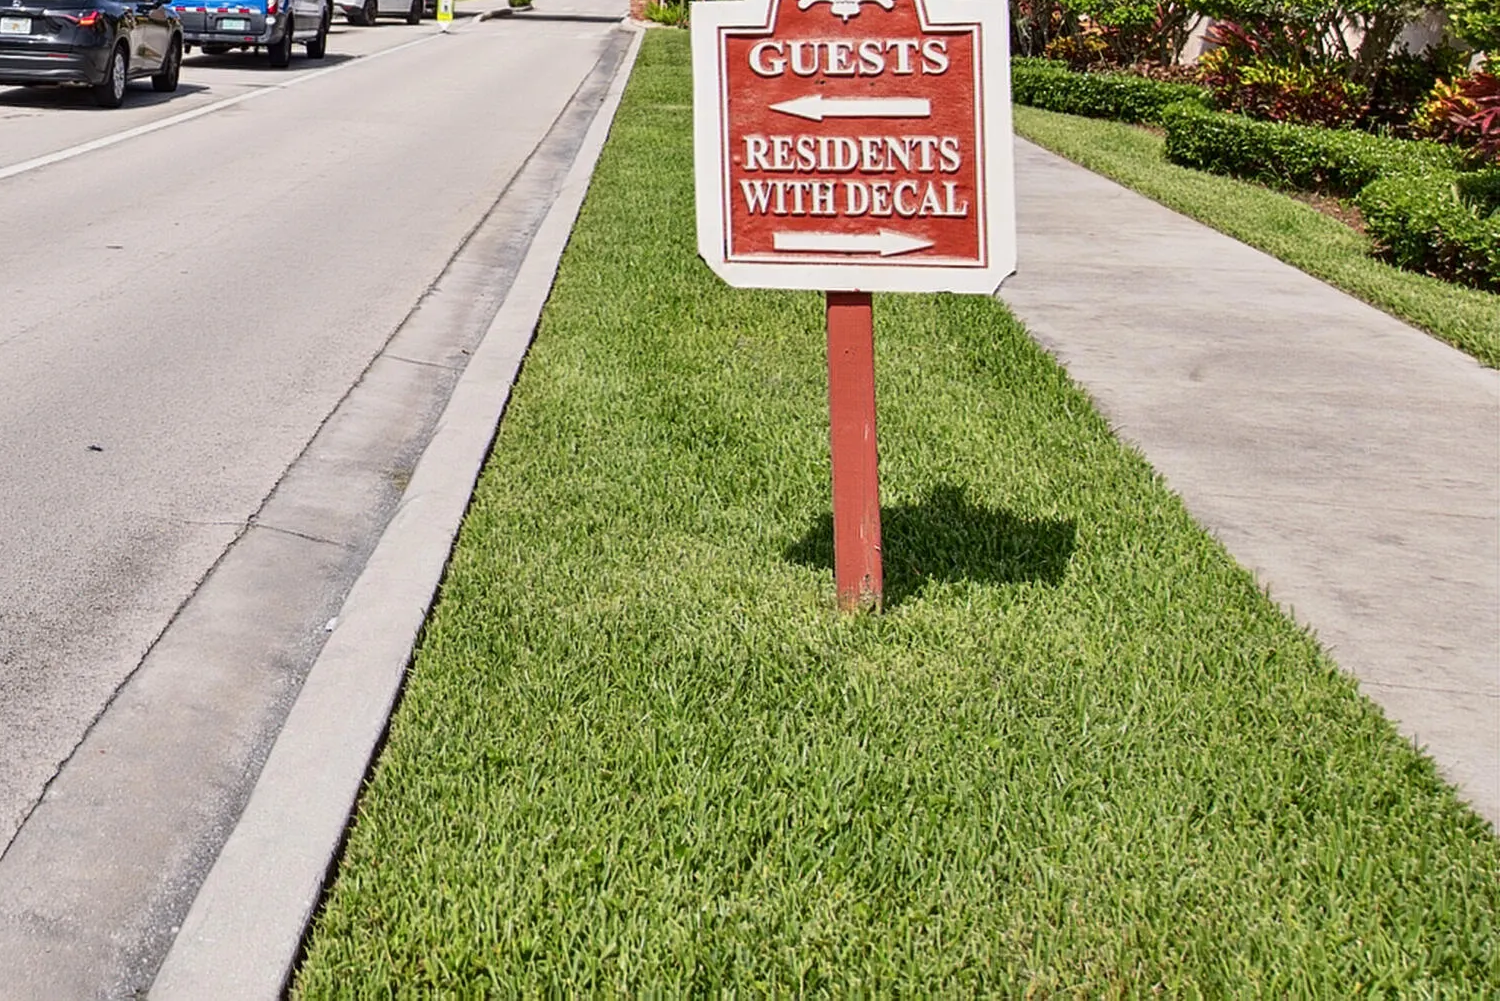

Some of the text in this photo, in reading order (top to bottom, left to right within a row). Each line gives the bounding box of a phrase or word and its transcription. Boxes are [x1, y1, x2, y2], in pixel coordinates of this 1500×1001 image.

[749, 39, 949, 76] GUESTS
[742, 135, 962, 172] RESIDENTS
[740, 179, 968, 216] WITH DECAL
